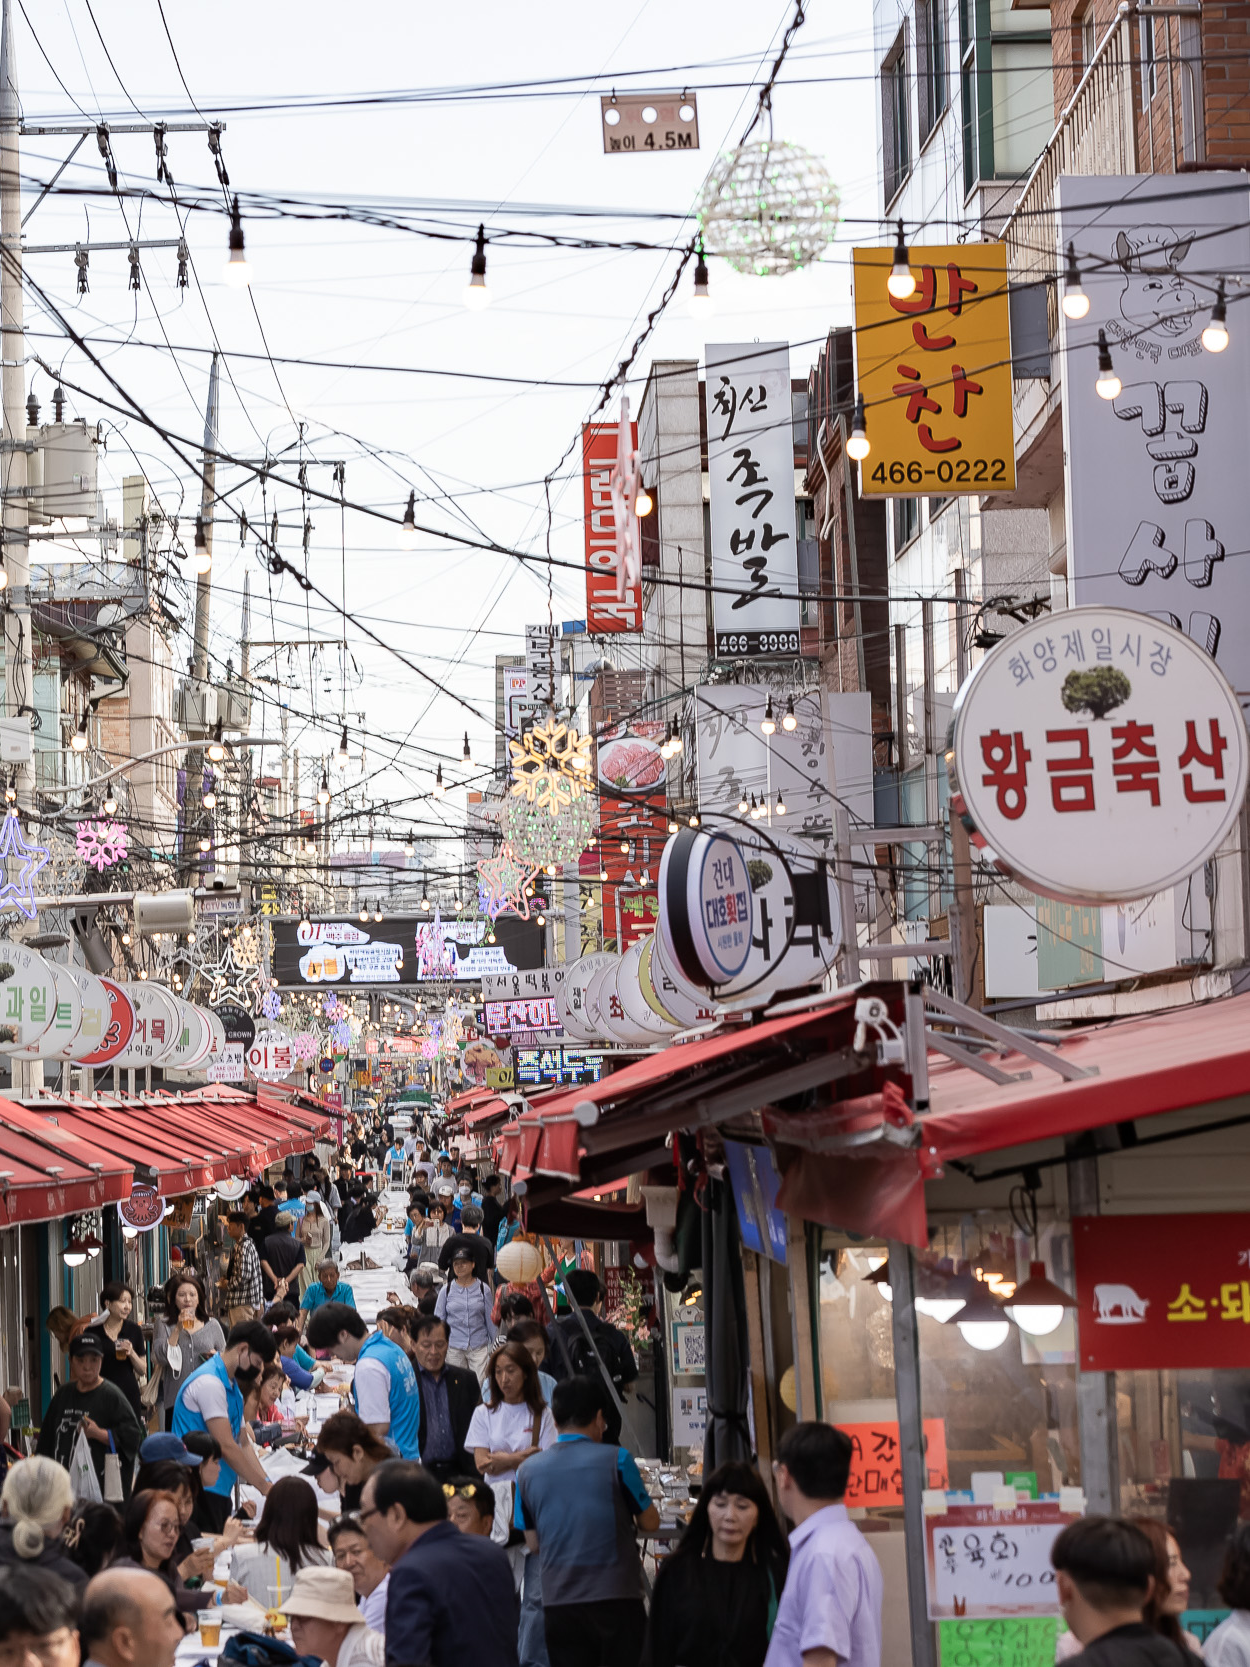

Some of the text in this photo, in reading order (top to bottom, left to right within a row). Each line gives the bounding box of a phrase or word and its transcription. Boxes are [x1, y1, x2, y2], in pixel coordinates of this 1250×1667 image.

[644, 131, 692, 149] 4.5M
[889, 263, 983, 454] 반찬
[871, 458, 1007, 485] 466-0222
[726, 448, 790, 611] 족발
[1007, 627, 1173, 688] 화양제일시장
[979, 717, 1228, 820] 황금축산
[712, 856, 735, 890] 건대
[706, 890, 749, 930] 대호횟집
[250, 1046, 293, 1069] 이불
